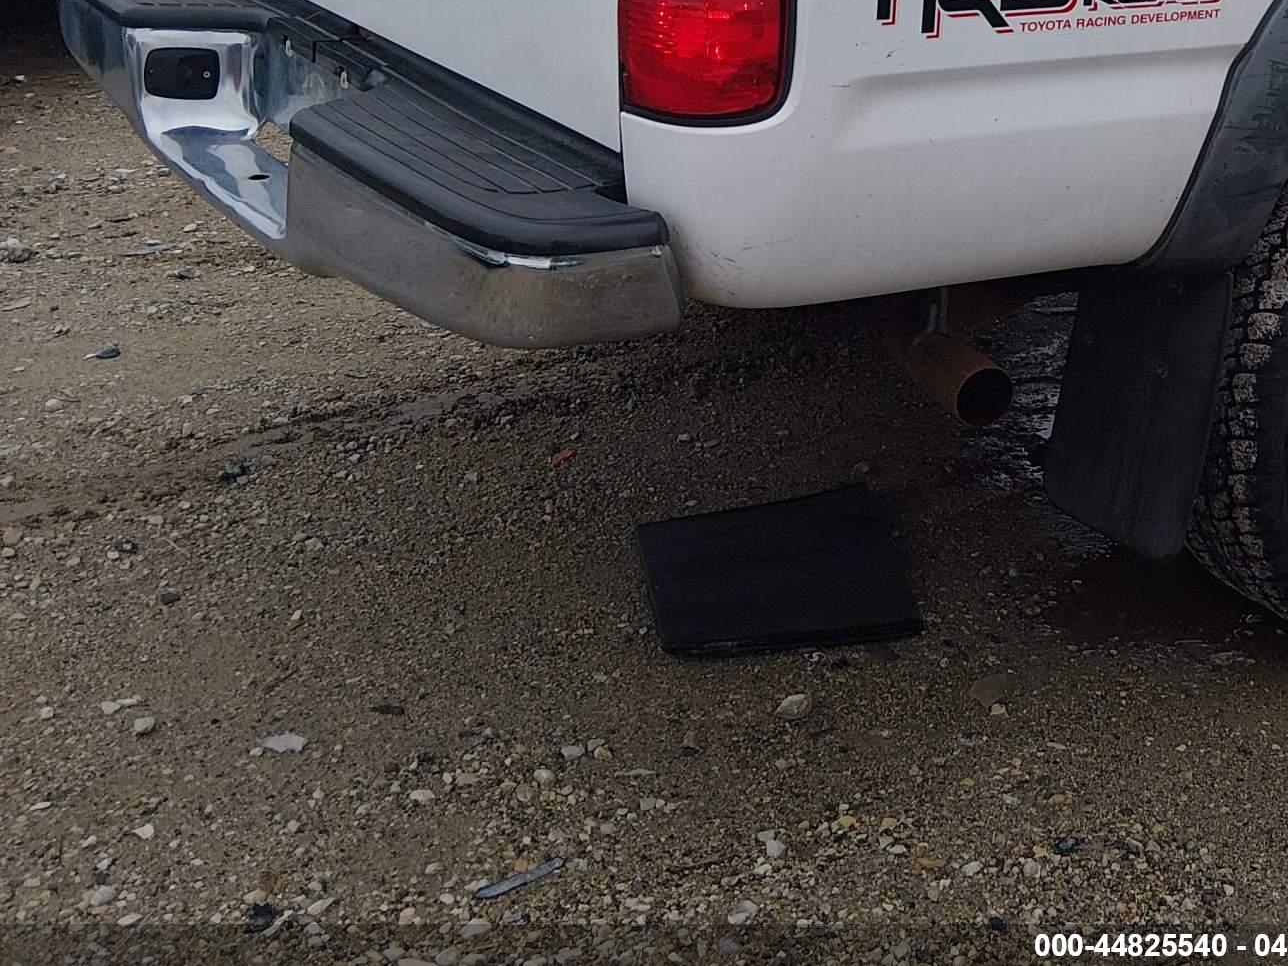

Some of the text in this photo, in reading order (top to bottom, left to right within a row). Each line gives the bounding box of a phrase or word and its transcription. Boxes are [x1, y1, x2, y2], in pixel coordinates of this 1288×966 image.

[1020, 8, 1222, 33] TOYOTA RACING DEVELOPMENT
